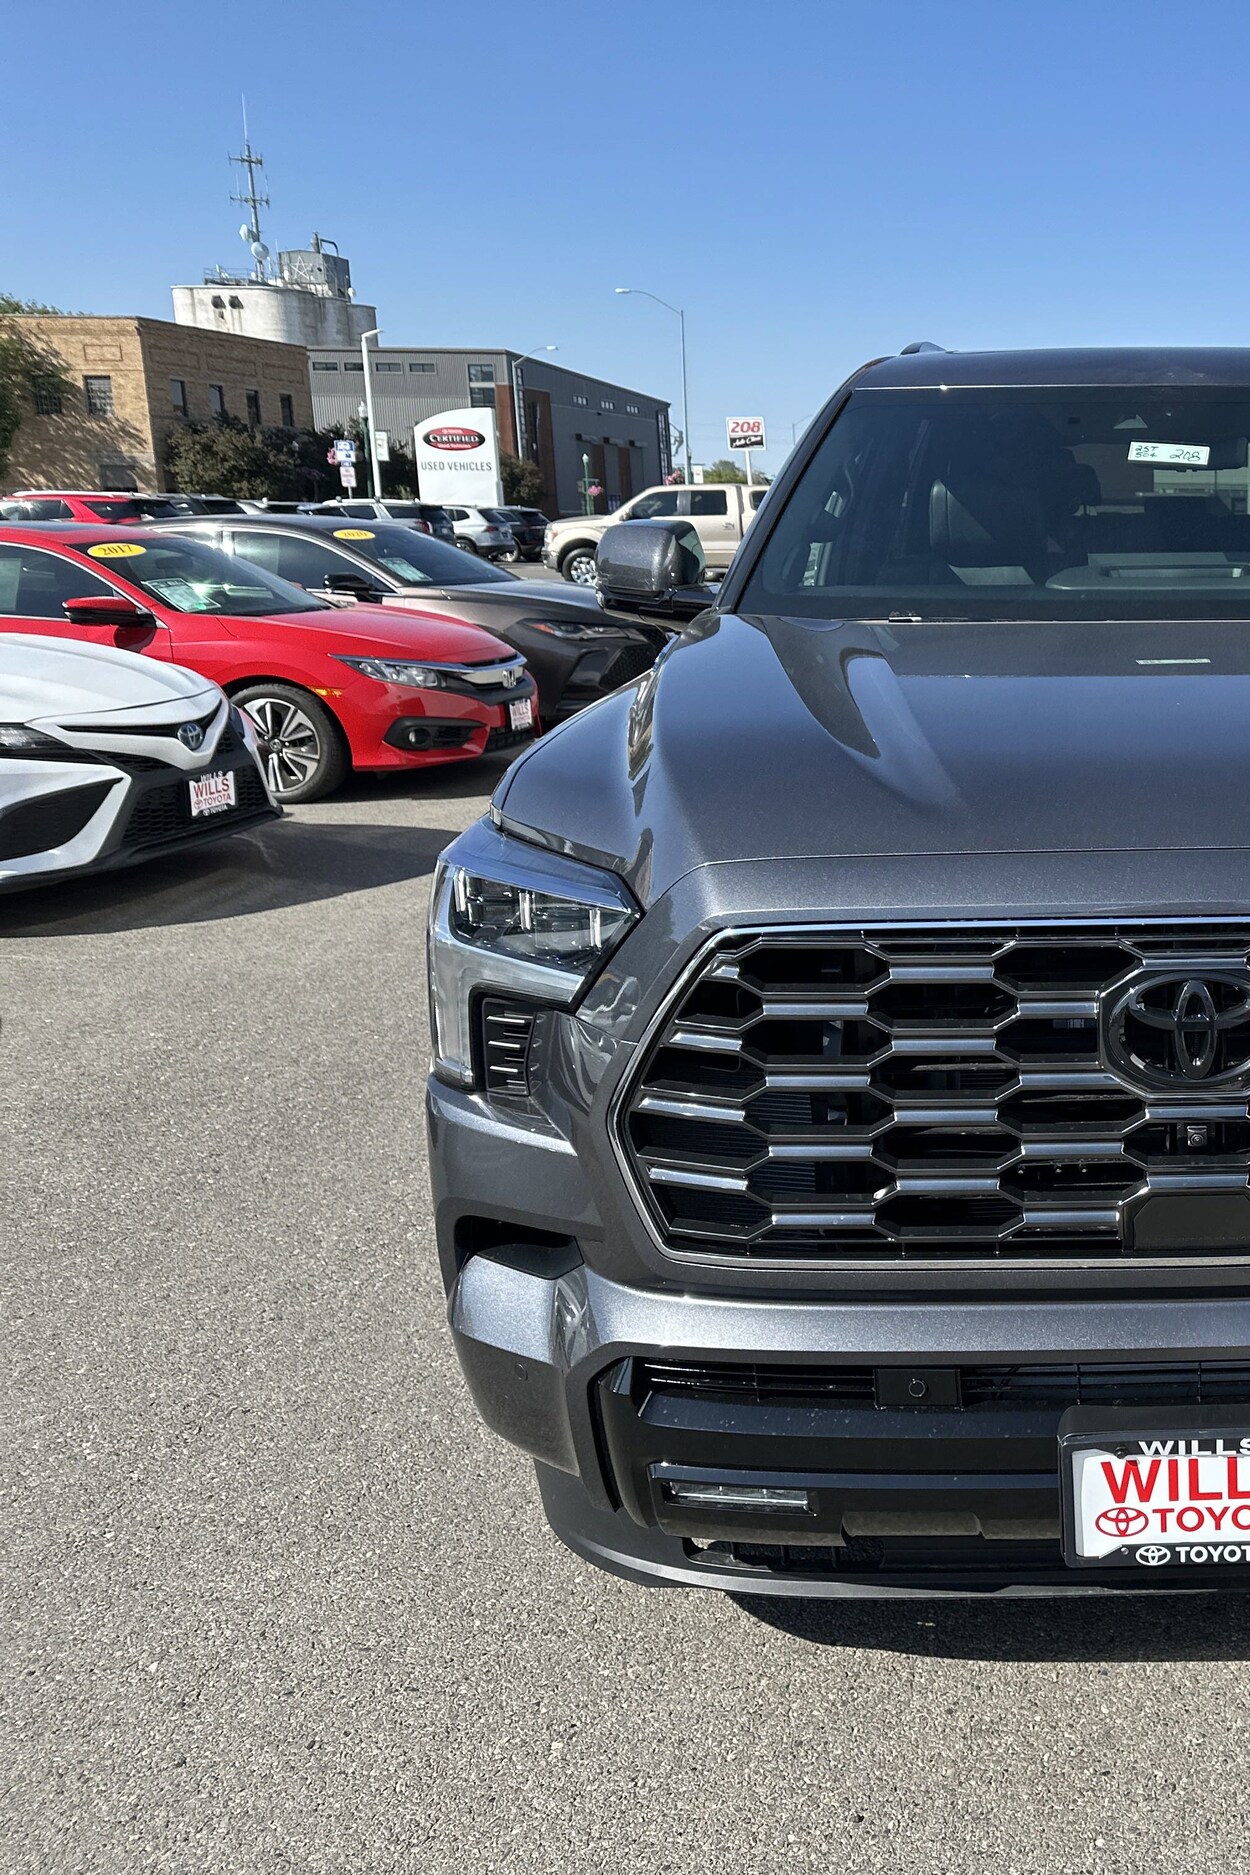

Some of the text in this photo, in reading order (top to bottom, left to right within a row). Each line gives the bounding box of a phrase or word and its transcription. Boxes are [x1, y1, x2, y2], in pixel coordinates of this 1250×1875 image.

[730, 421, 761, 433] 208
[429, 433, 480, 443] CERTIFIED
[1169, 448, 1201, 461] 208
[420, 461, 492, 471] USED VEHICLES
[98, 544, 133, 556] 2017
[193, 777, 230, 799] WILLS
[203, 792, 232, 806] TOYOTA
